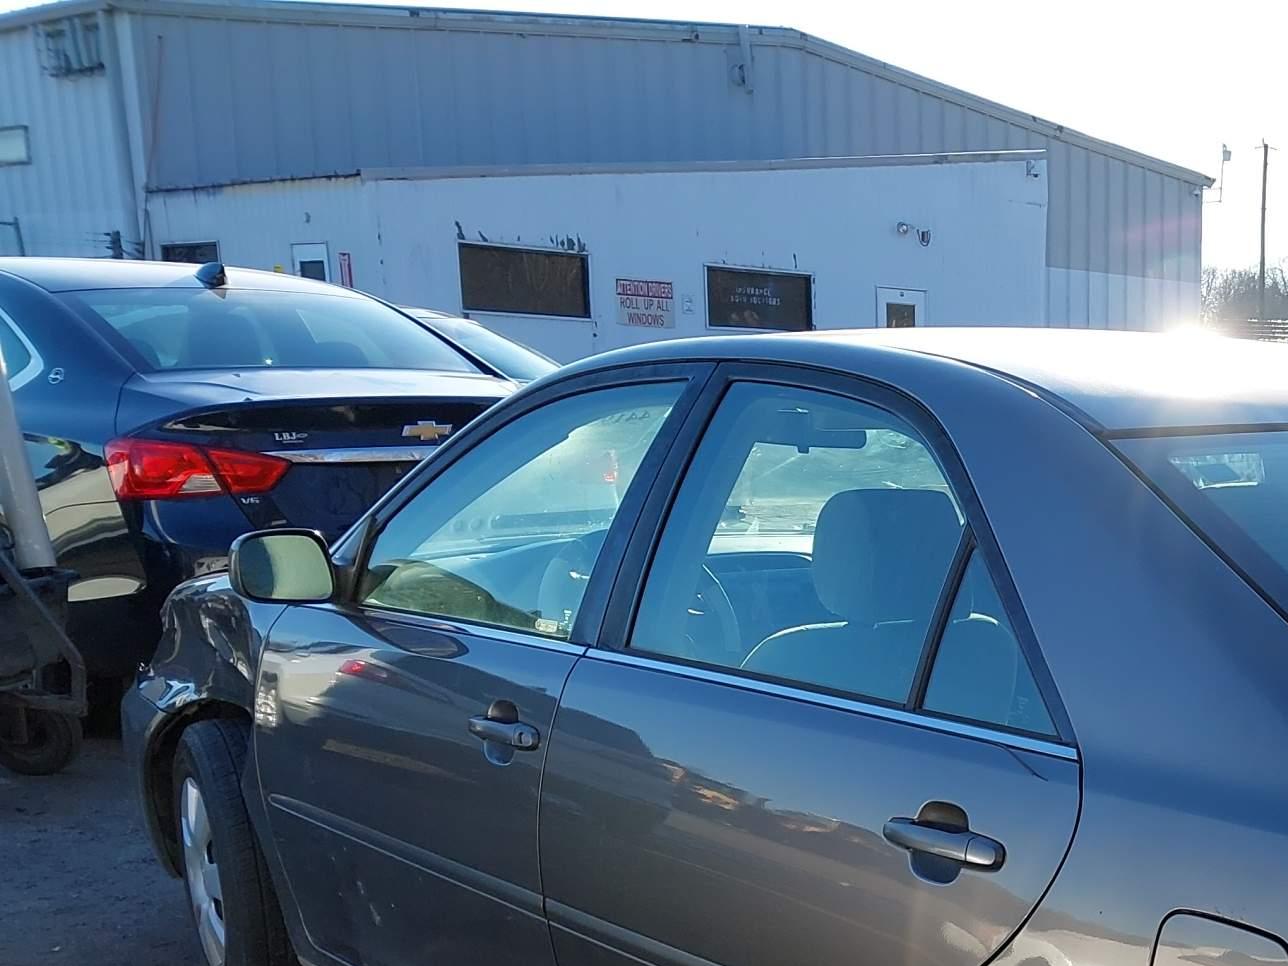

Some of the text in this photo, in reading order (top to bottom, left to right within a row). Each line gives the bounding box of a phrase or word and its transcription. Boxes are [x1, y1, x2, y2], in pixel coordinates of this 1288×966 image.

[617, 281, 672, 298] ATTENTION DRIVERS
[620, 297, 640, 310] ROLL
[644, 299, 654, 310] UP
[657, 299, 670, 312] ALL
[627, 312, 664, 327] WINDOWS
[274, 432, 297, 441] LBJ
